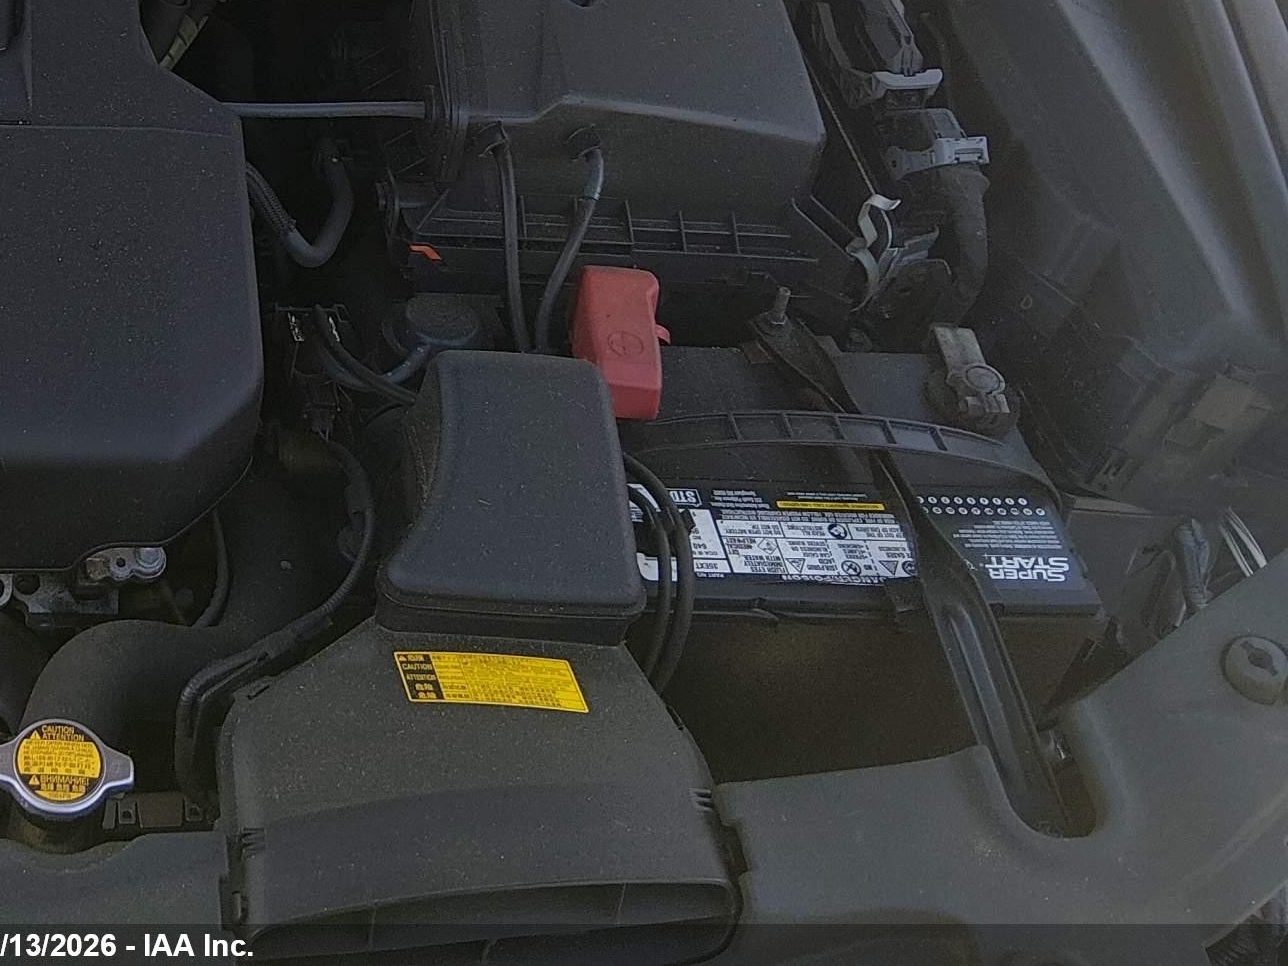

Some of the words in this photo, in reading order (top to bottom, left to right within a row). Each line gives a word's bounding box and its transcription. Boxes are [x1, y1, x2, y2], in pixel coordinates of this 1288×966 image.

[985, 556, 1069, 570] START
[988, 569, 1066, 582] SUPER
[42, 725, 75, 734] CAUTION
[42, 733, 85, 742] ATTENTION
[40, 775, 89, 786] ВНИМАНИЕ!
